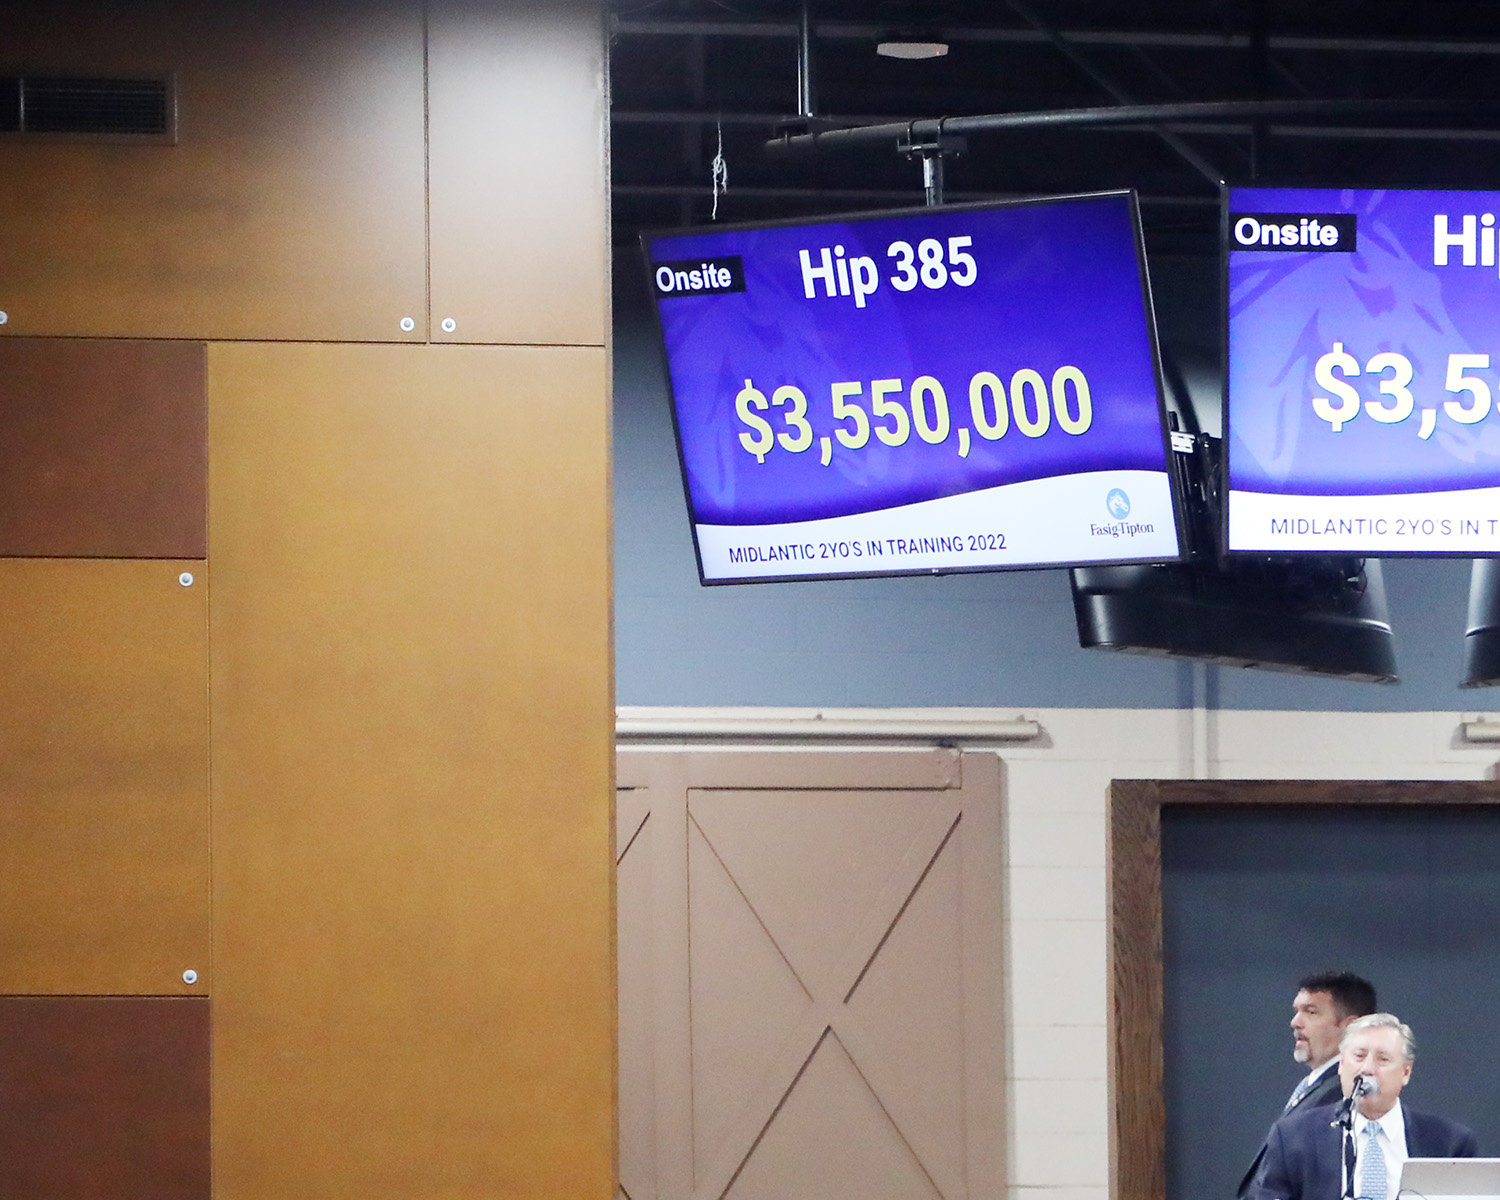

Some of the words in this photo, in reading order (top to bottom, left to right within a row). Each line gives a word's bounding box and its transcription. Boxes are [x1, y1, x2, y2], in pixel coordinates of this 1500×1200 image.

[1234, 218, 1340, 247] Onsite
[655, 261, 732, 293] Onsite
[799, 244, 880, 309] Hip
[887, 235, 978, 291] 385
[735, 365, 1094, 467] $3,550,000
[1089, 521, 1155, 538] Fasig-Tipton
[1270, 517, 1389, 536] MIDLANTIC
[1394, 517, 1453, 537] 2YO'S
[1459, 518, 1480, 536] IN
[728, 542, 816, 564] MIDLANTIC
[818, 540, 864, 560] 2YO'S
[867, 539, 883, 557] IN
[886, 536, 964, 556] TRAINING
[969, 533, 1007, 551] 2022
